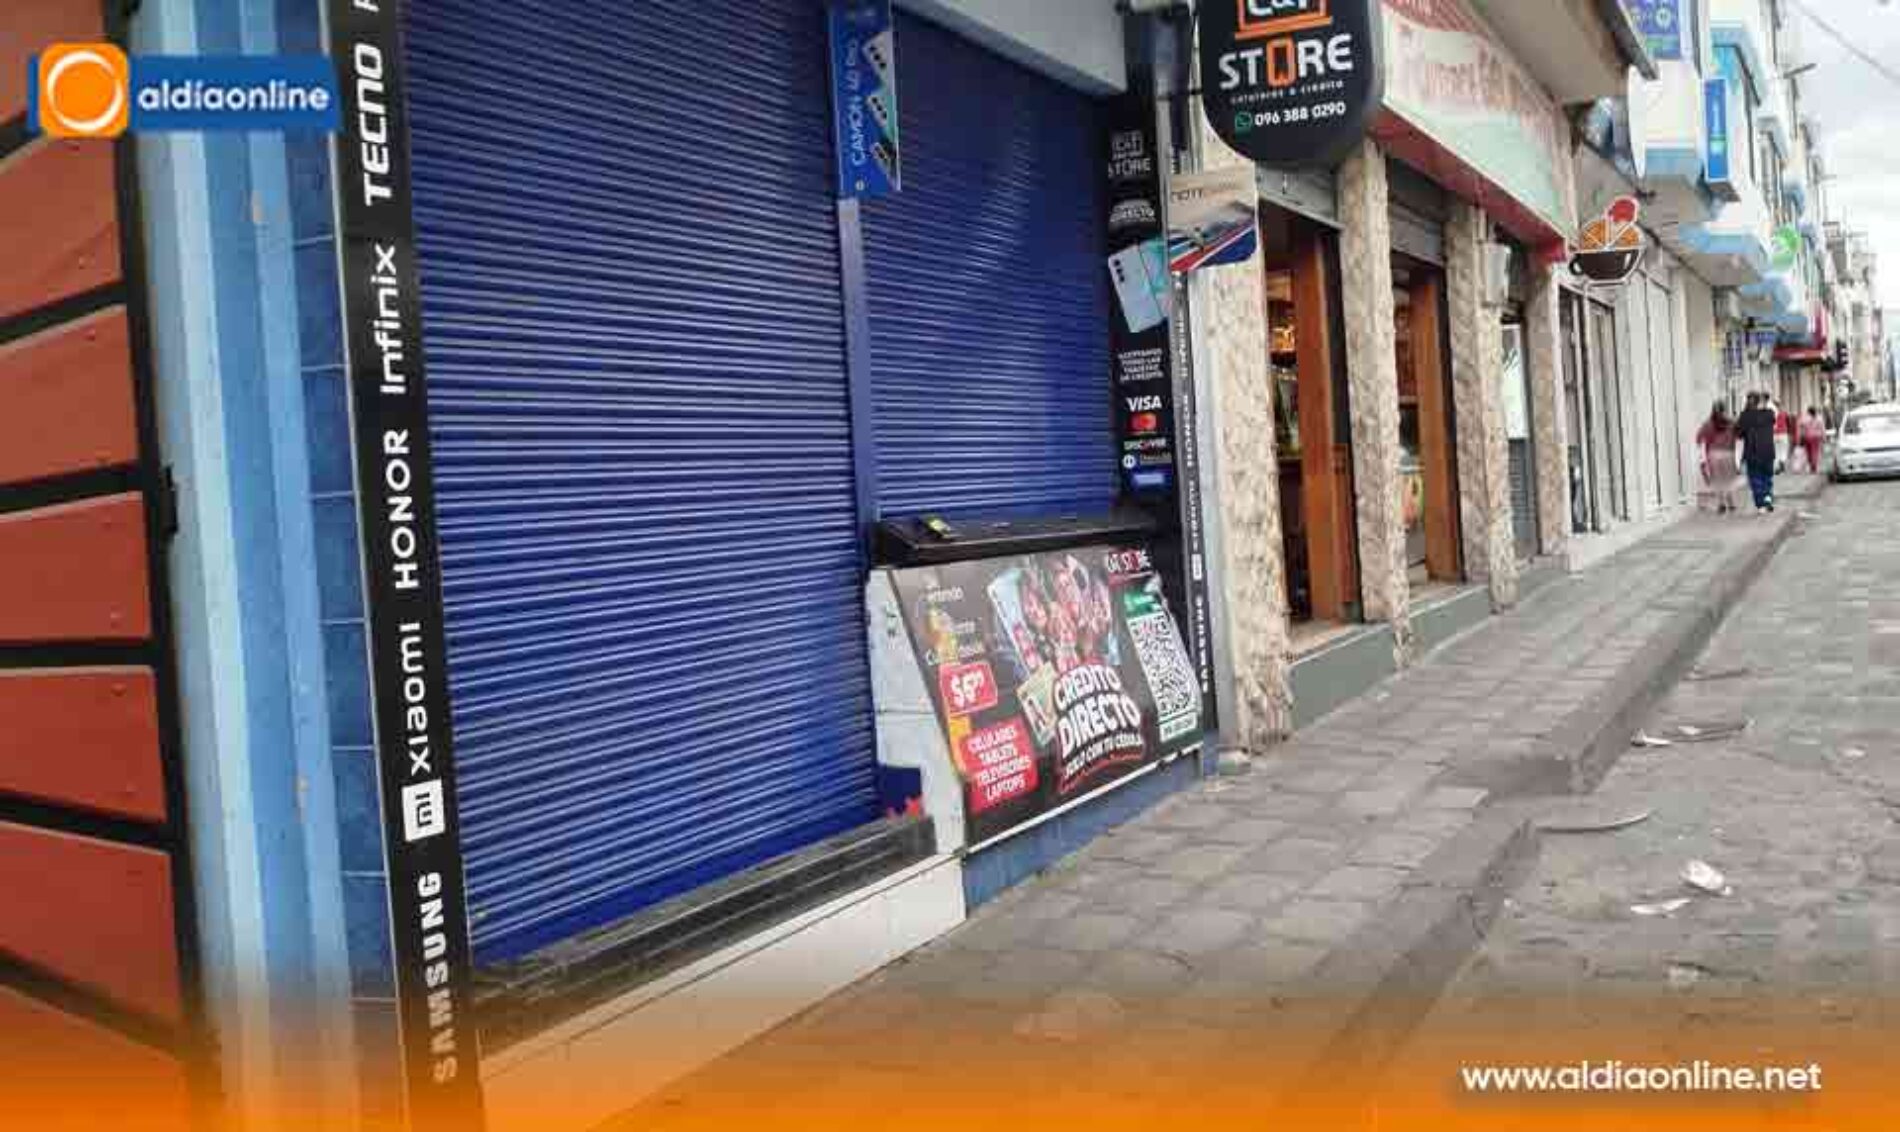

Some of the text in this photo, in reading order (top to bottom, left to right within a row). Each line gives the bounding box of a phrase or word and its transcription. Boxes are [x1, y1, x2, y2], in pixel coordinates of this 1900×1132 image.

[355, 44, 391, 206] TECNO
[1218, 33, 1353, 90] STORE
[1254, 101, 1346, 127] 096 388 0290
[371, 243, 406, 395] Infinix
[1126, 395, 1162, 412] VISA
[383, 428, 420, 589] HONOR
[400, 622, 432, 776] xiaomi
[1059, 693, 1141, 760] DIRECTO
[418, 871, 458, 1084] SAMSUNG
